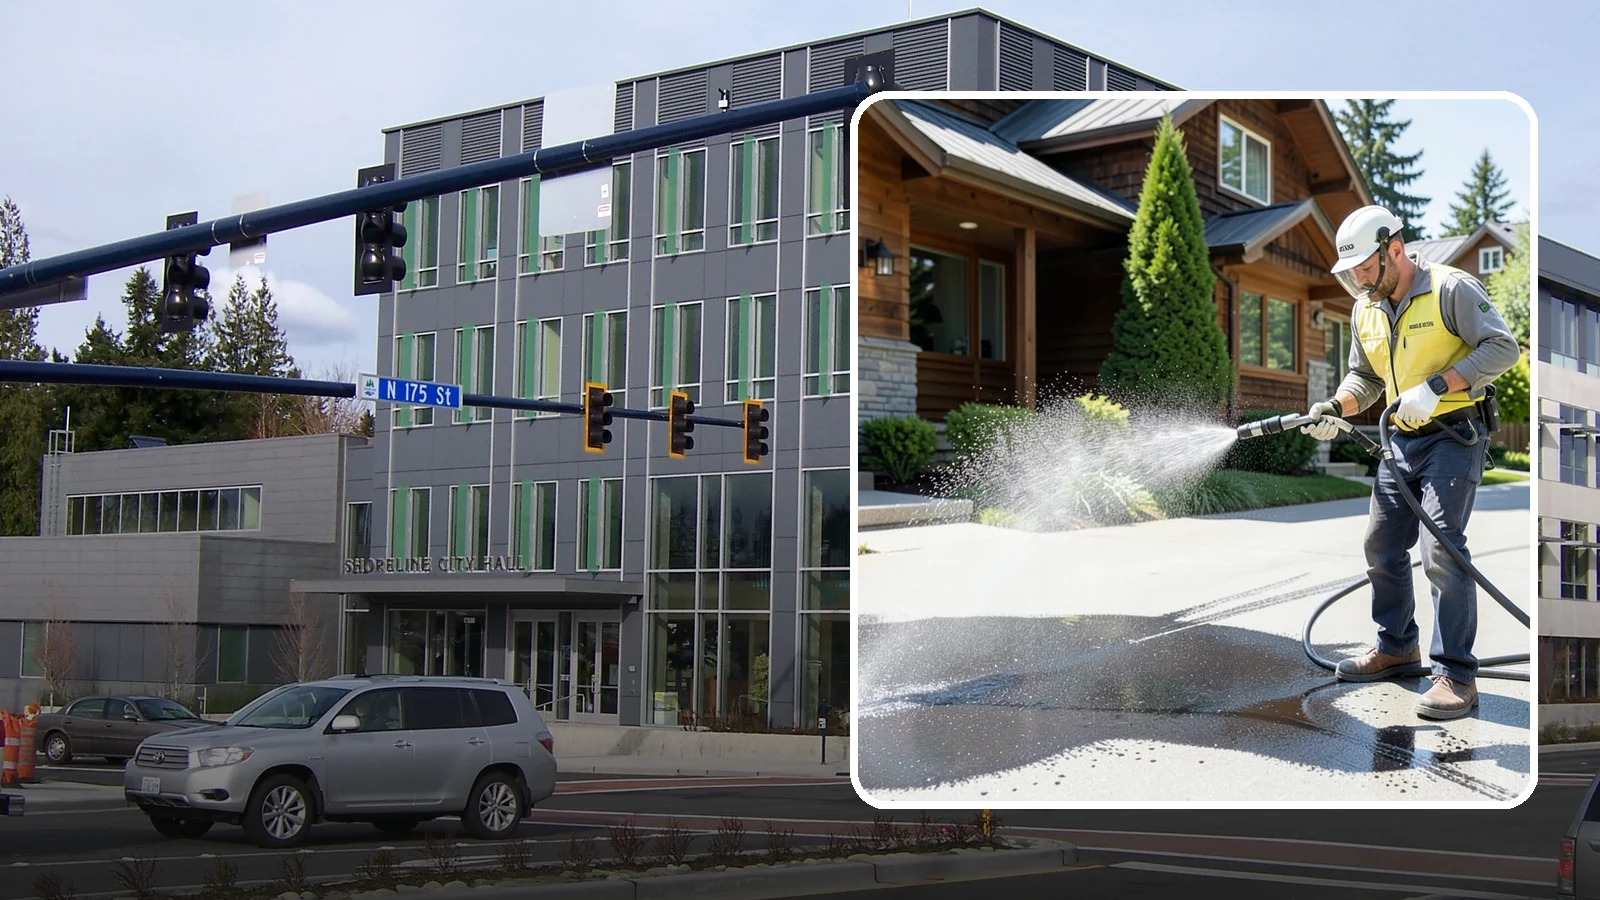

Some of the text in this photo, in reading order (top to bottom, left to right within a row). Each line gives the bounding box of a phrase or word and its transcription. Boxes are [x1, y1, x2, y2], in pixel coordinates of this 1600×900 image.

[387, 380, 452, 406] N 175 St
[343, 556, 526, 574] SHORELINE CITY HALL
